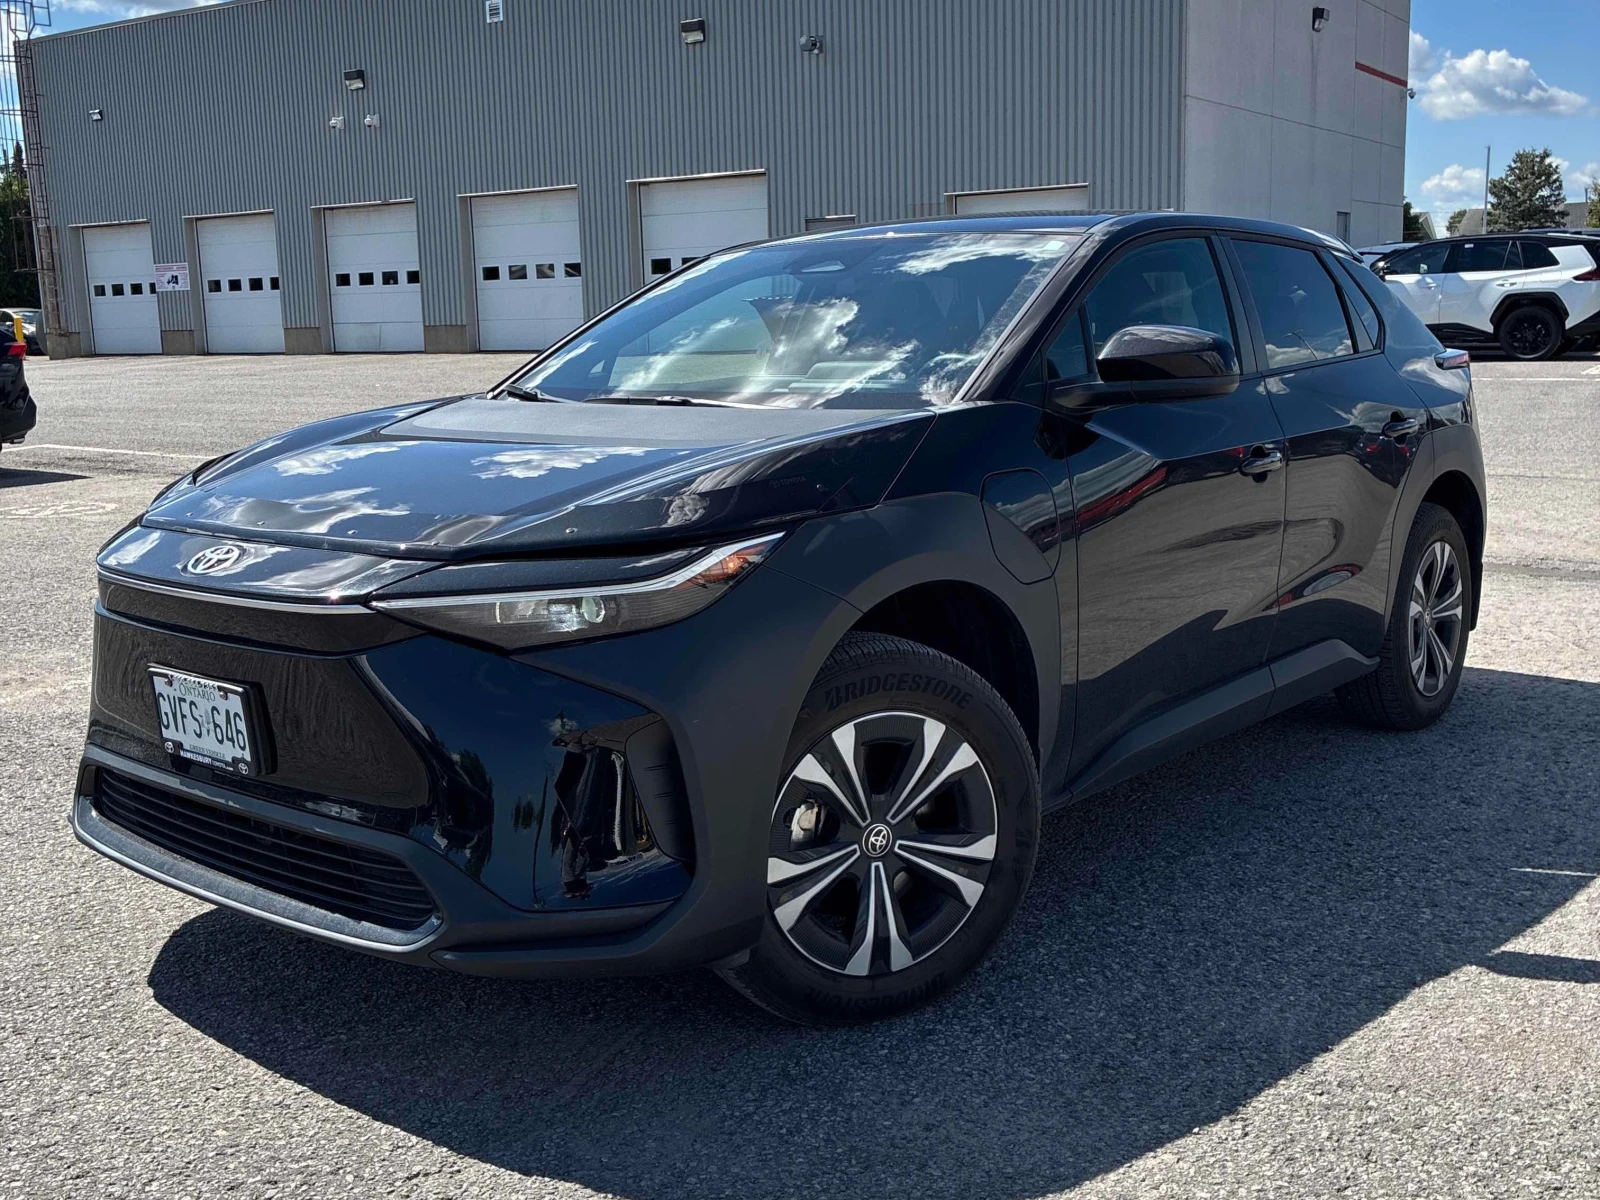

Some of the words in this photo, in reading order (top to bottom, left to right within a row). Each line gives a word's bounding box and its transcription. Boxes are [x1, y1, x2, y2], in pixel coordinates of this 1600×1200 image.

[779, 476, 807, 486] TOYOTA
[178, 682, 216, 702] ONTARIO
[824, 672, 975, 713] BRIDGESTONE
[157, 691, 203, 739] GVFS
[210, 705, 247, 752] 646
